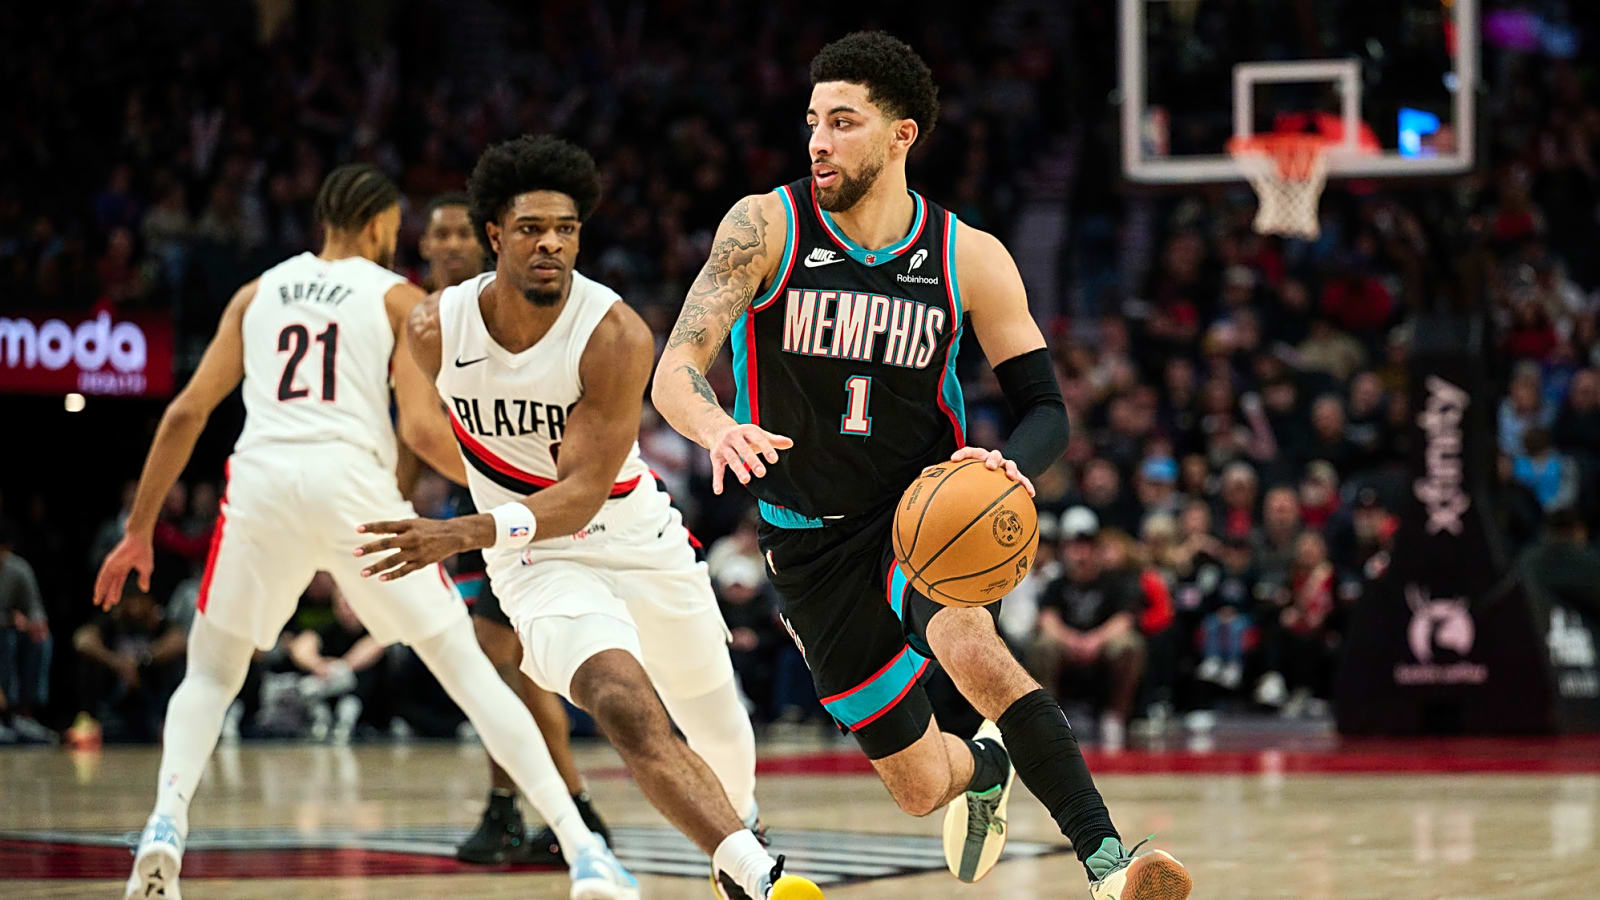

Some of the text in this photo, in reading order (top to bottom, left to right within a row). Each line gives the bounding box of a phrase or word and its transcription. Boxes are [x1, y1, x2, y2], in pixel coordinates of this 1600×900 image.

[809, 248, 836, 261] NIKE
[896, 274, 939, 285] Robinhood
[279, 282, 353, 305] RUPERT
[0, 310, 147, 373] moda
[782, 288, 945, 370] MEMPHIS
[277, 323, 338, 402] 21
[451, 396, 578, 441] BLAZER
[840, 375, 872, 436] 1
